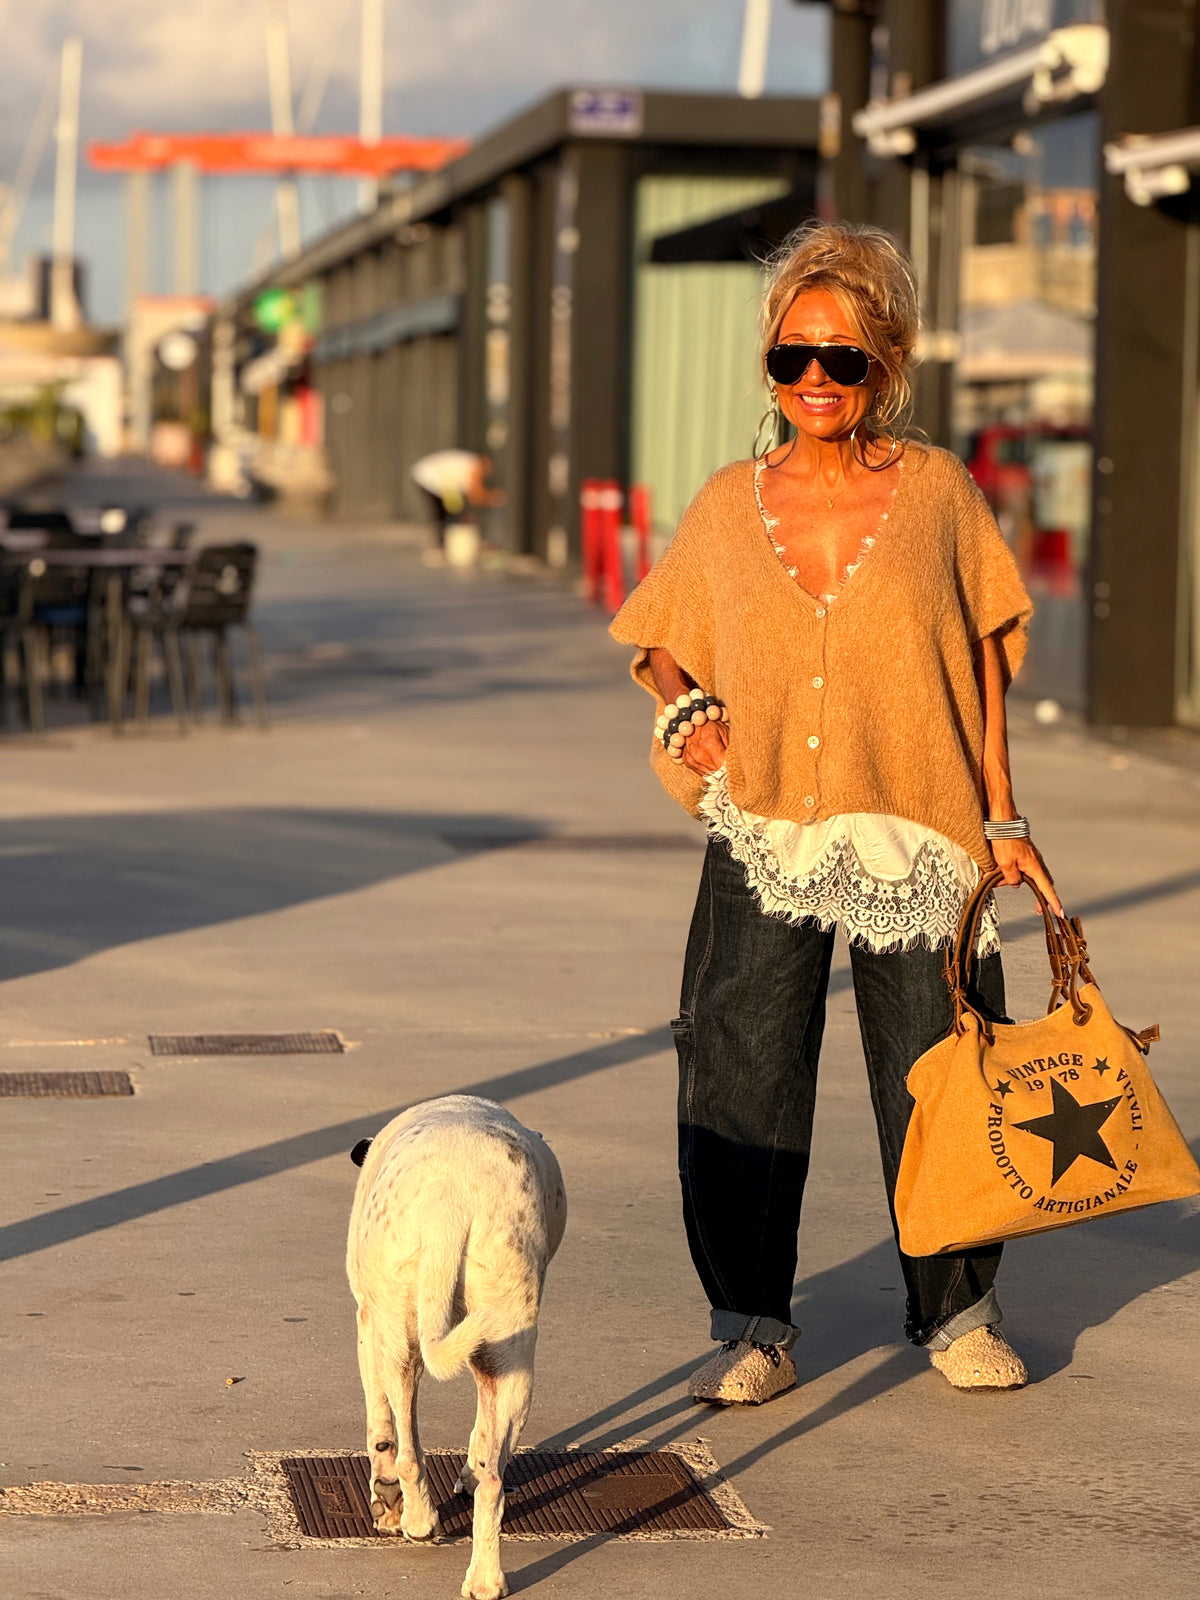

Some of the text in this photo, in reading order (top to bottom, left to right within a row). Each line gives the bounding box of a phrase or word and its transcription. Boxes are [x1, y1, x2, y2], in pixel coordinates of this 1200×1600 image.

[1007, 1053, 1083, 1081] VINTAGE
[1026, 1068, 1080, 1092] 19 78
[988, 1102, 1034, 1200] PRODOTTO
[1033, 1159, 1138, 1213] ARTIGIANALE
[1116, 1068, 1143, 1131] ITALIA
